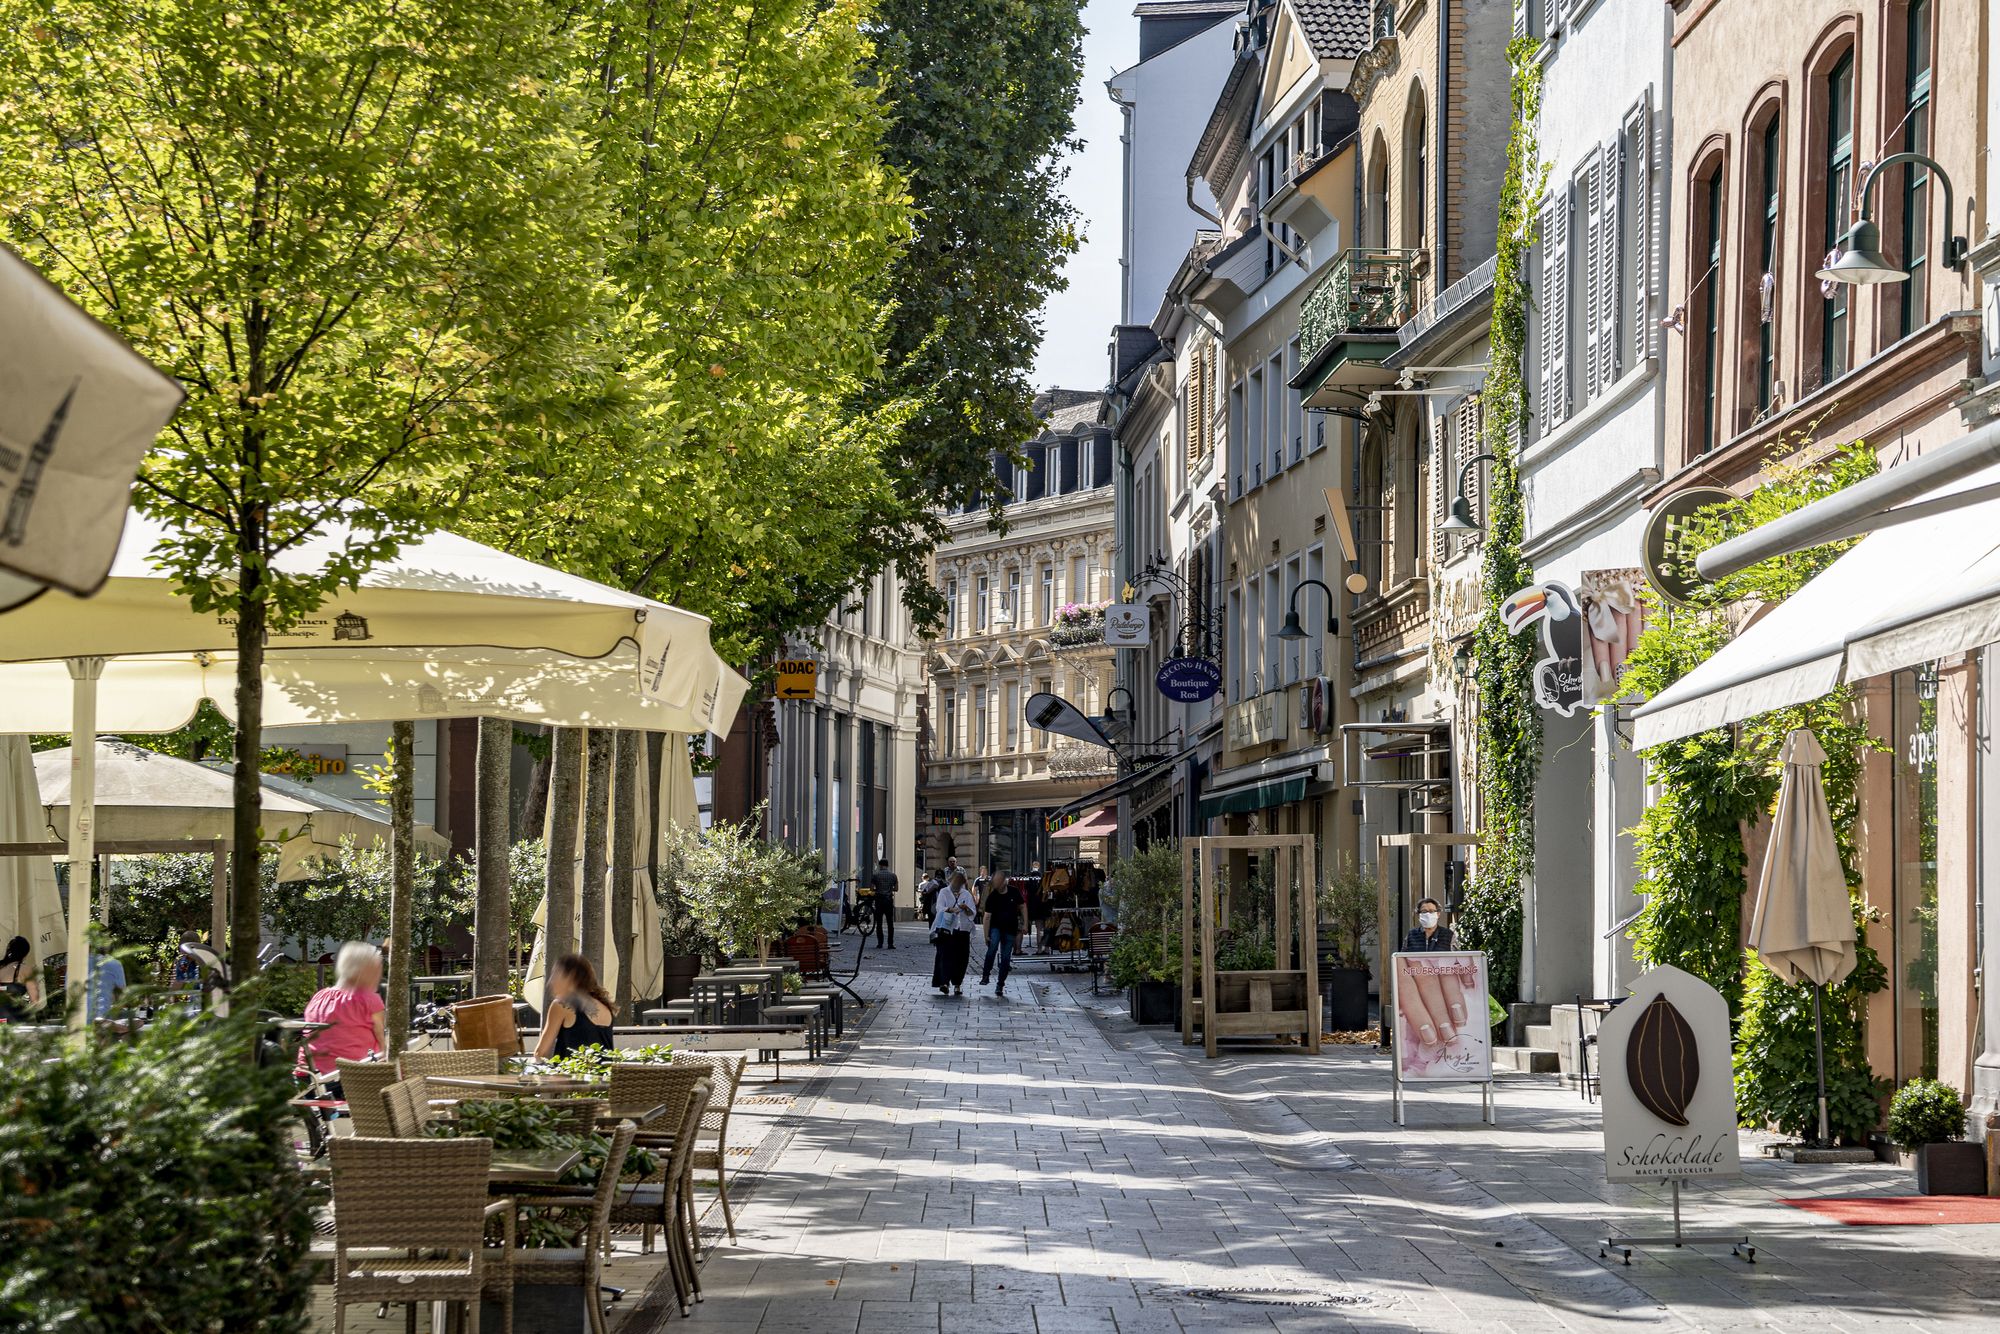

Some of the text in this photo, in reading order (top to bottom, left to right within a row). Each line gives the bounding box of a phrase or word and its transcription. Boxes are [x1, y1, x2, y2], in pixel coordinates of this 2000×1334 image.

[779, 661, 814, 675] ADAC
[1160, 662, 1219, 681] SECOND HAND
[1170, 679, 1209, 689] Boutique
[1180, 690, 1200, 699] Rosi
[1617, 1133, 1728, 1167] Schokolade
[1667, 1167, 1714, 1175] GLÜCKLICH
